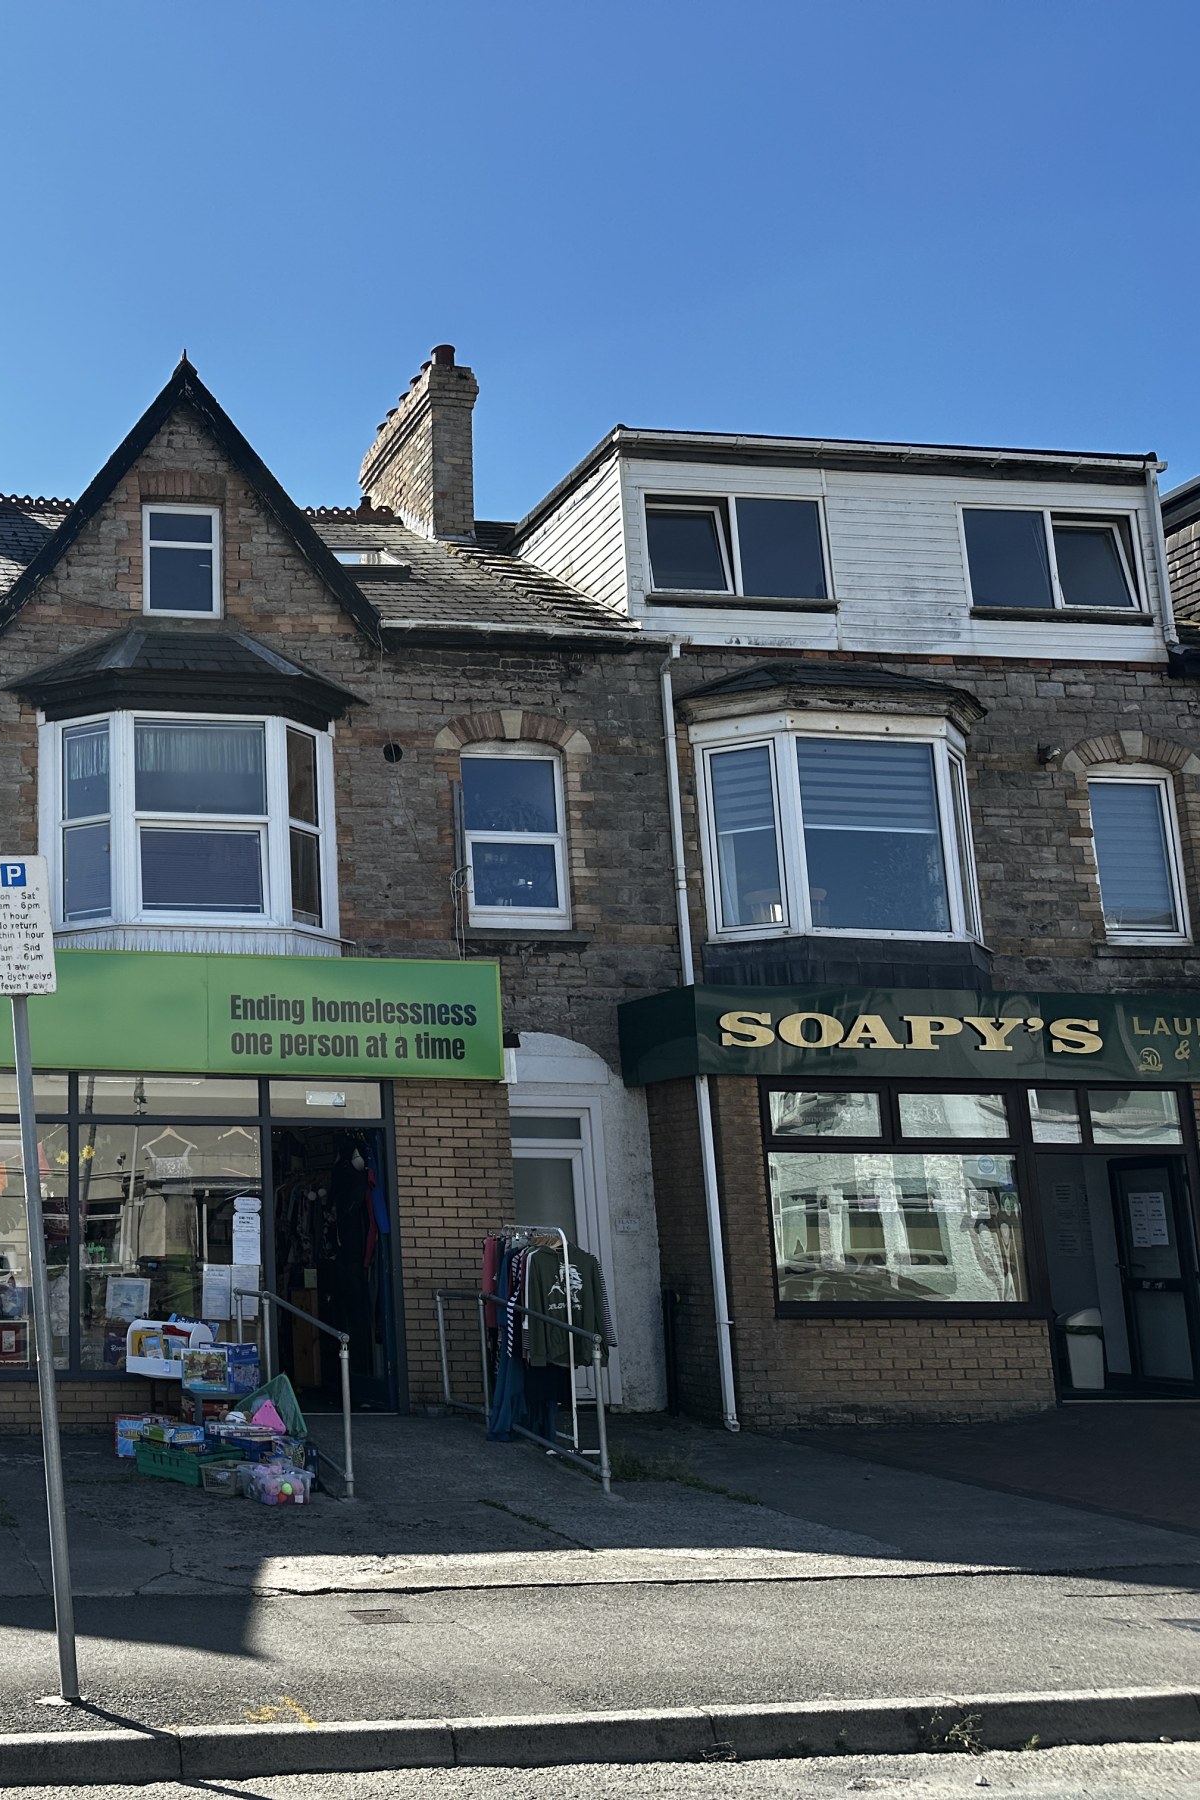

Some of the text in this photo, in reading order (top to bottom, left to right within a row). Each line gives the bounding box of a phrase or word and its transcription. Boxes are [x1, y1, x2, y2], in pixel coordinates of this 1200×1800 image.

[6, 865, 22, 886] P
[21, 892, 36, 900] Sat
[3, 912, 29, 920] 1 hour
[11, 922, 38, 930] return
[25, 931, 45, 939] hour
[23, 943, 41, 952] Sad
[7, 963, 11, 971] 1
[7, 971, 52, 982] dychwelyd
[0, 982, 22, 990] fewn
[25, 982, 29, 990] 1
[230, 993, 477, 1027] Ending homelessness
[1132, 1016, 1200, 1036] LAU
[718, 1010, 1104, 1055] SOAPY'S
[231, 1031, 466, 1061] one person at a time
[1174, 1039, 1191, 1060] &
[1142, 1051, 1158, 1067] 50
